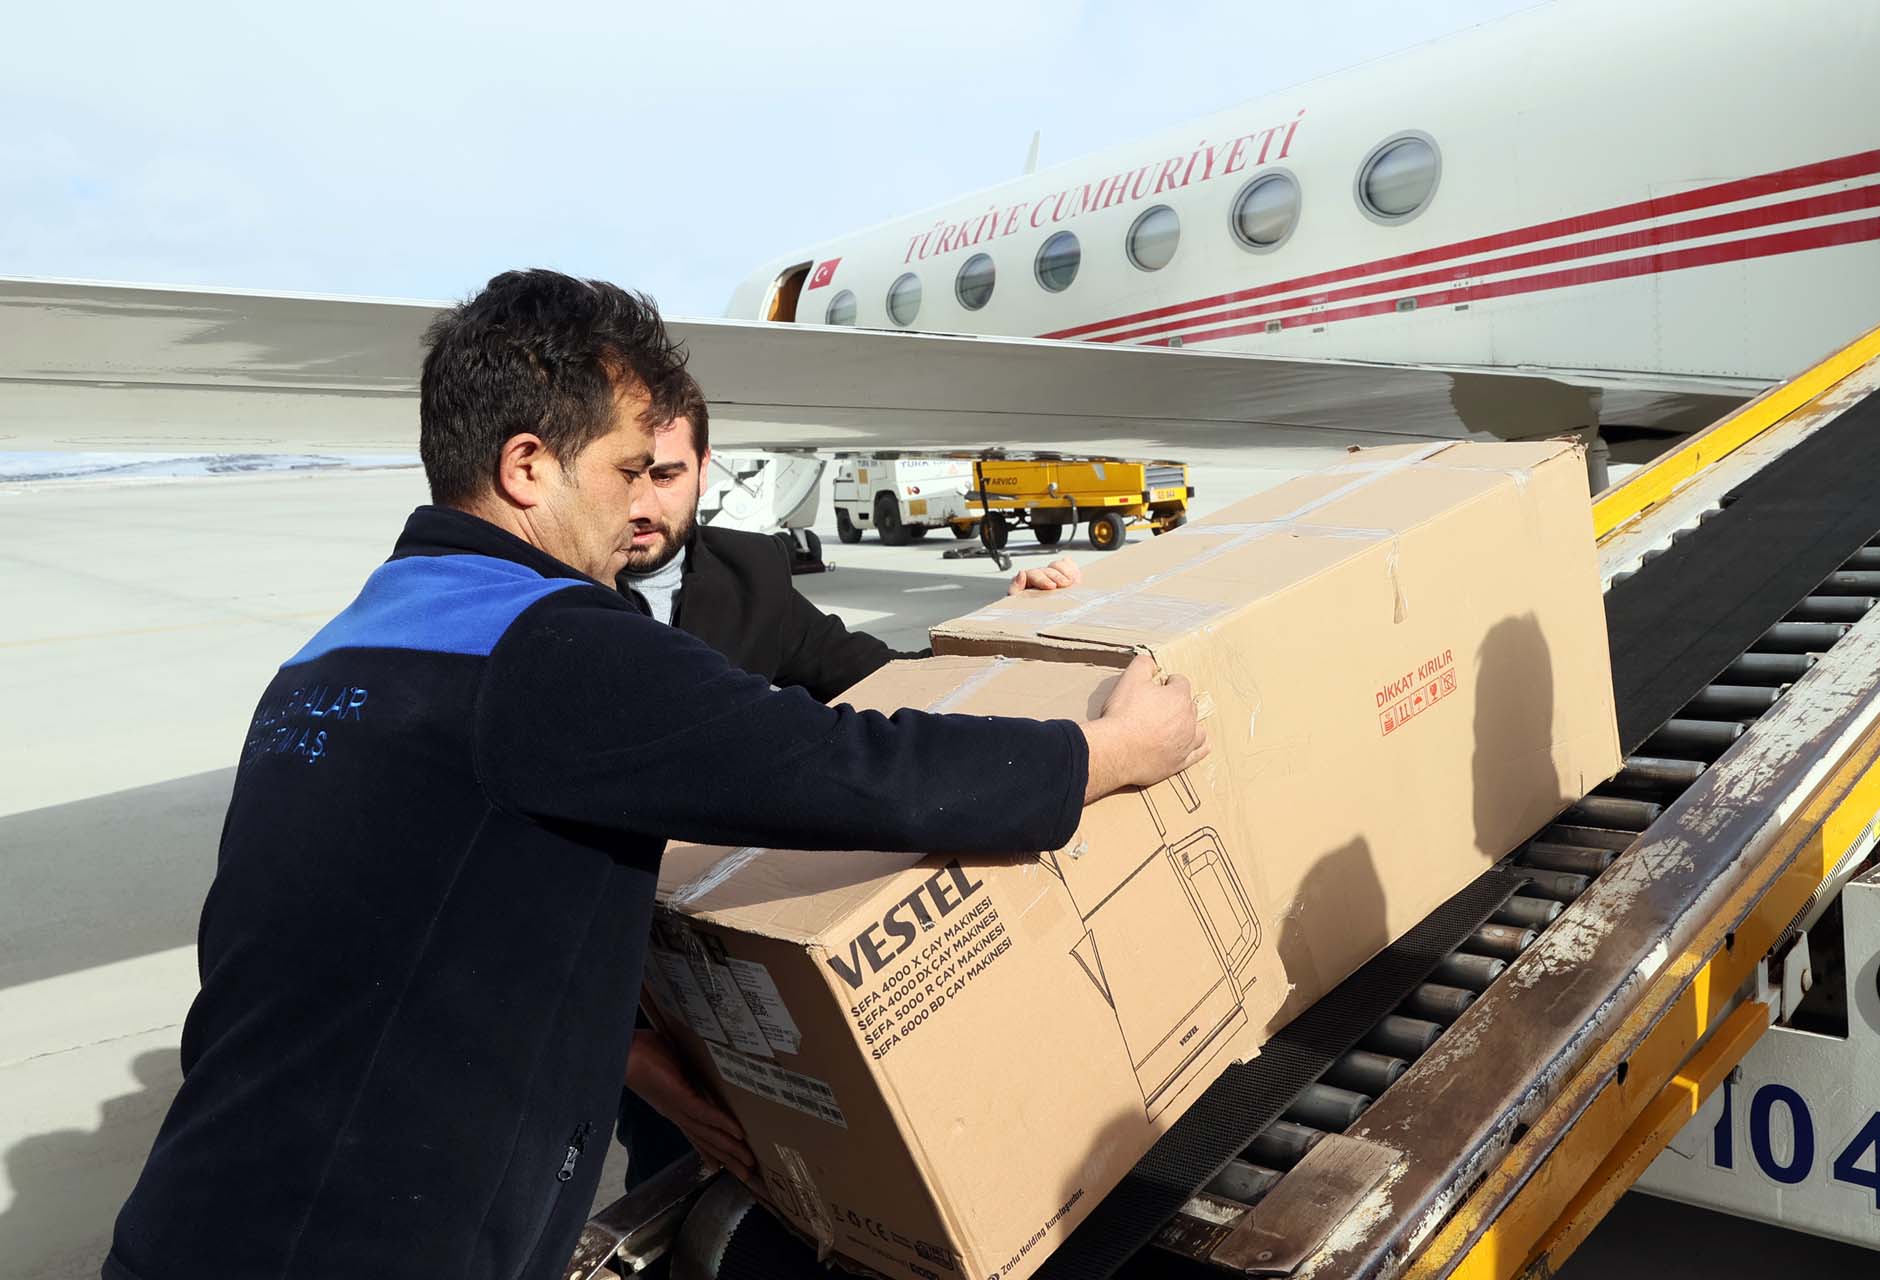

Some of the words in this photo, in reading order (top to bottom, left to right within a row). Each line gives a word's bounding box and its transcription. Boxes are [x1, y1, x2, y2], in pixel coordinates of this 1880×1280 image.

[904, 203, 1028, 264] TÜRKİYE
[1030, 108, 1306, 228] CUMHURİYETİ
[1376, 672, 1413, 708] DİKKAT
[1418, 649, 1453, 680] KIRILIR
[826, 858, 984, 991] VESTEL
[851, 991, 881, 1018] SEFA
[882, 965, 911, 994] 4000
[912, 956, 922, 967] X
[923, 937, 945, 965] ÇAY
[943, 896, 993, 942] MAKİNESİ
[858, 1004, 888, 1031] SEFA
[887, 978, 917, 1007] 4000
[917, 965, 933, 984] DX
[931, 949, 952, 975] ÇAY
[952, 909, 999, 953] MAKİNESİ
[864, 1018, 895, 1045] SEFA
[895, 992, 925, 1021] 5000
[925, 984, 935, 995] R
[935, 964, 956, 990] ÇAY
[957, 922, 1006, 967] MAKİNESİ
[872, 1034, 902, 1060] SEFA
[901, 1008, 930, 1037] 6000
[929, 995, 945, 1012] BD
[945, 976, 967, 1002] ÇAY
[966, 937, 1013, 982] MAKİNESİ
[1179, 1025, 1200, 1046] VESTEL
[1019, 1227, 1047, 1257] Holding
